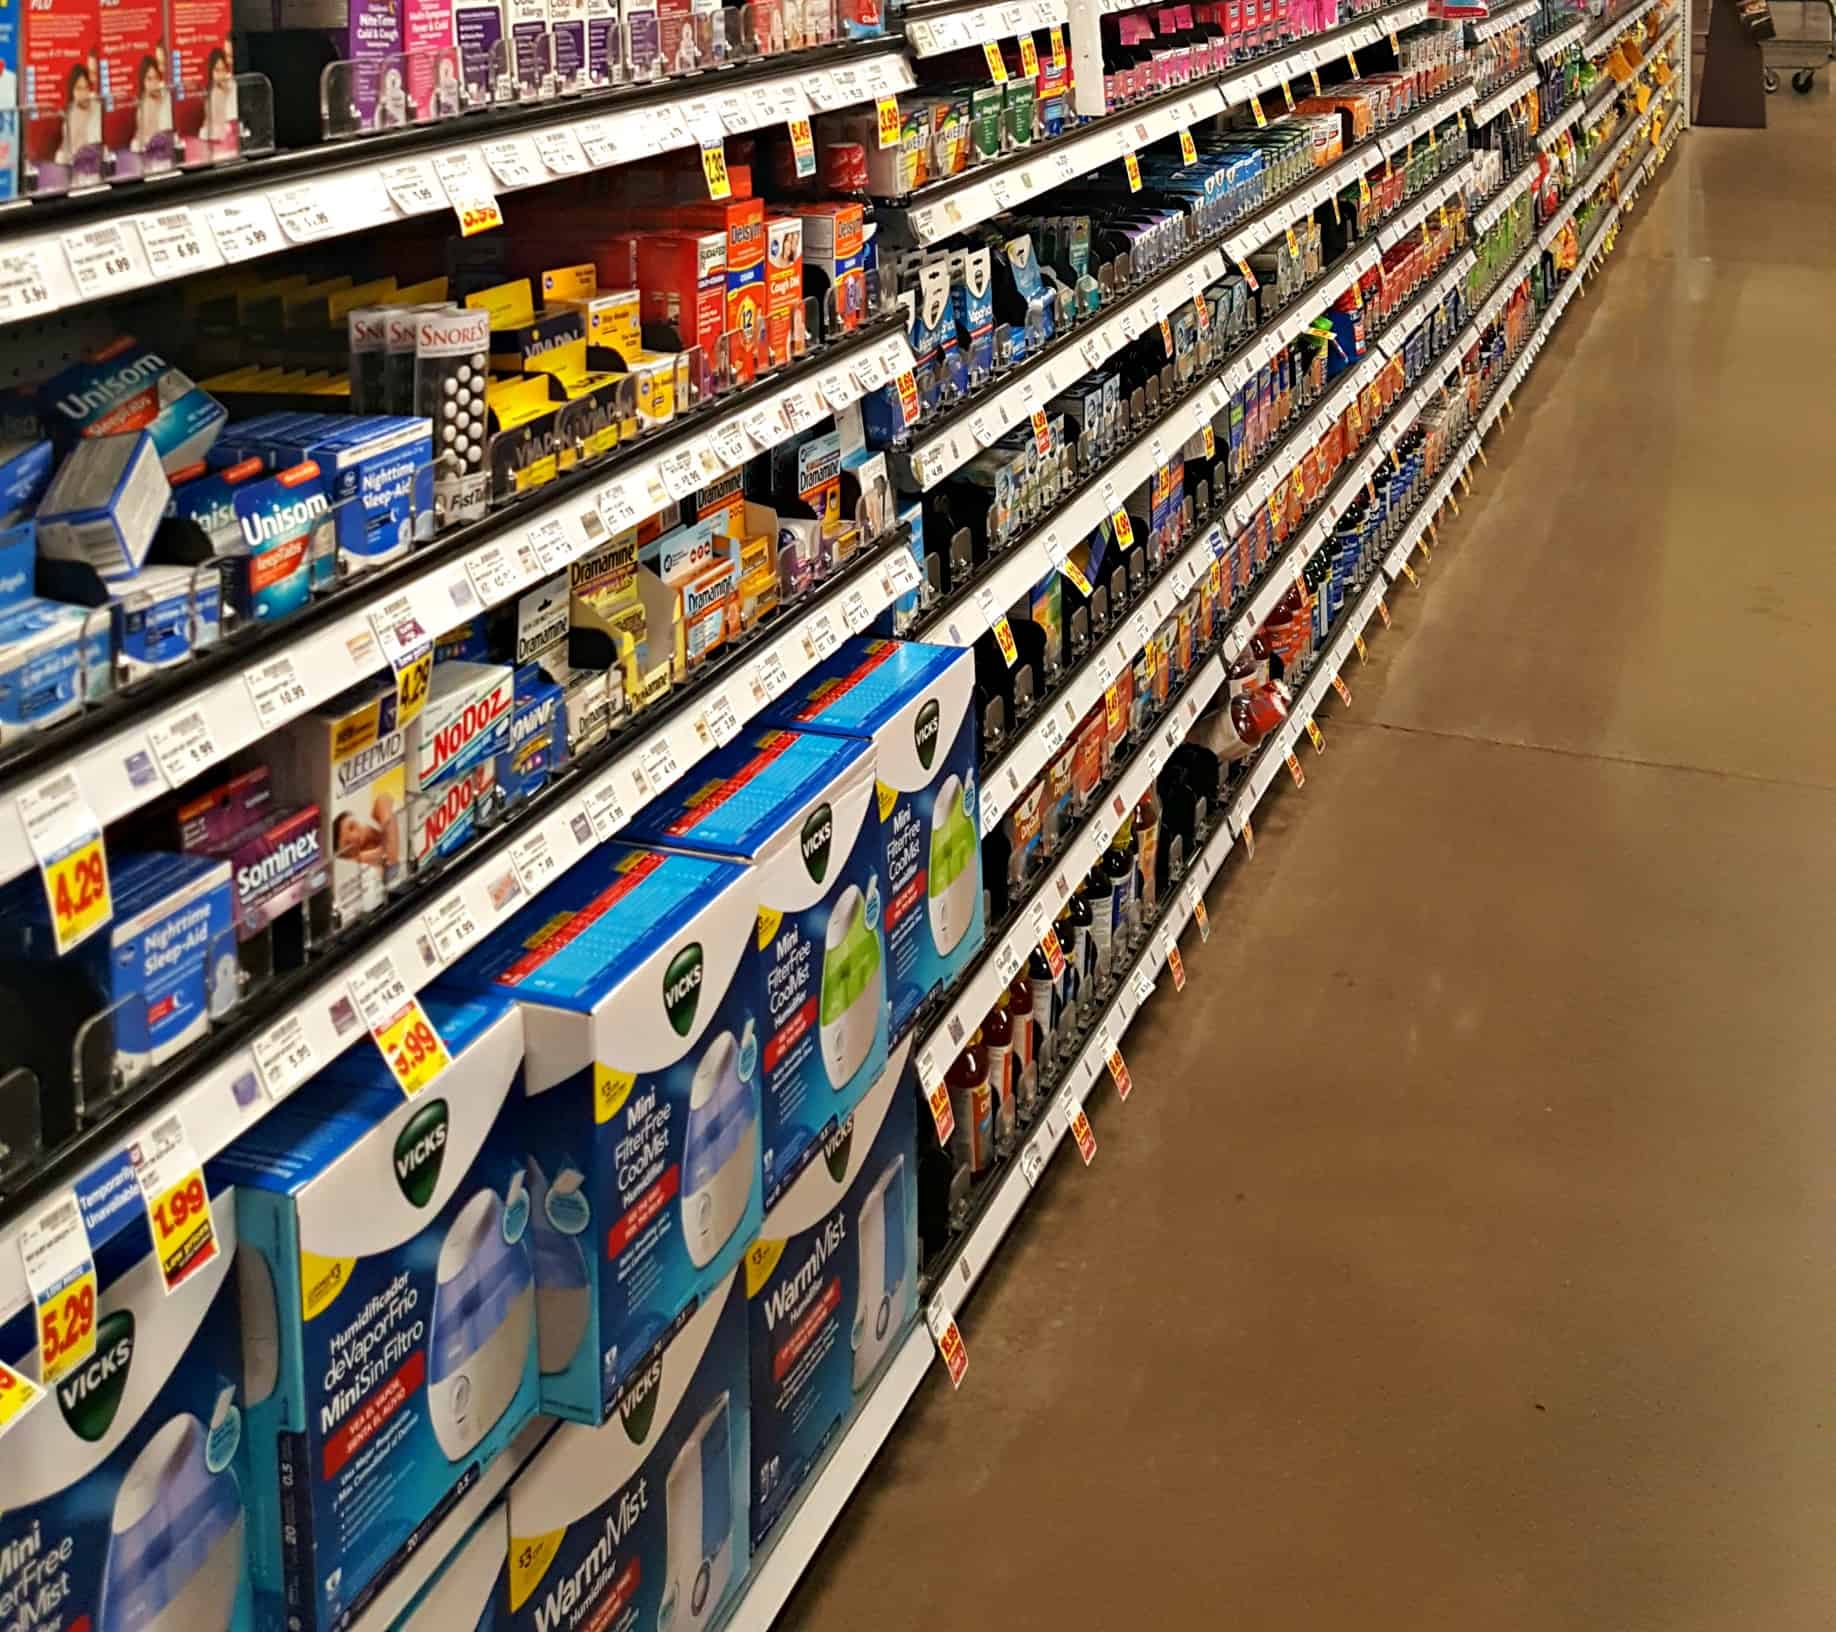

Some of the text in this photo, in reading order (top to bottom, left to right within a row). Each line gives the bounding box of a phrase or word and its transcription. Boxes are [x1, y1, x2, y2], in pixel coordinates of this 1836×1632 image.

[731, 222, 762, 245] Delsym
[55, 351, 167, 420] Unisom
[362, 475, 413, 510] Sleep-Aid
[363, 461, 415, 492] Nighttime
[696, 471, 742, 511] Dramamine
[799, 459, 840, 491] Dramamine
[241, 492, 329, 546] Unisom
[570, 542, 636, 585] Dramamine
[687, 574, 733, 613] Dramamine
[518, 616, 568, 659] Dramamine
[915, 718, 940, 747] VICKS
[802, 823, 831, 854] VICKS
[892, 803, 912, 833] Mini
[55, 850, 106, 920] 4.29
[237, 827, 321, 898] Sominex
[143, 902, 212, 954] Nighttime
[143, 925, 209, 976] Sleep-Aid
[775, 922, 799, 962] Mini
[665, 963, 702, 1010] VICKS
[767, 940, 812, 996] FilterFree
[769, 962, 811, 1014] CoolMist
[626, 1084, 657, 1130] Mini
[396, 1123, 447, 1179] VICKS
[614, 1102, 672, 1170] FilterFree
[617, 1128, 671, 1192] CoolMist
[822, 1112, 854, 1161] VICKS
[79, 1165, 136, 1210] Temporarily
[153, 1178, 206, 1240] 1.99
[763, 1210, 848, 1332] WarmMist
[42, 1284, 95, 1365] 5.29
[328, 1269, 410, 1354] Humidificador
[324, 1287, 418, 1392] deVaporFrío
[60, 1338, 133, 1410] VICKS
[319, 1318, 425, 1435] MiniSinFiltro
[621, 1358, 663, 1420] VICKS
[533, 1476, 649, 1632] WarmMist
